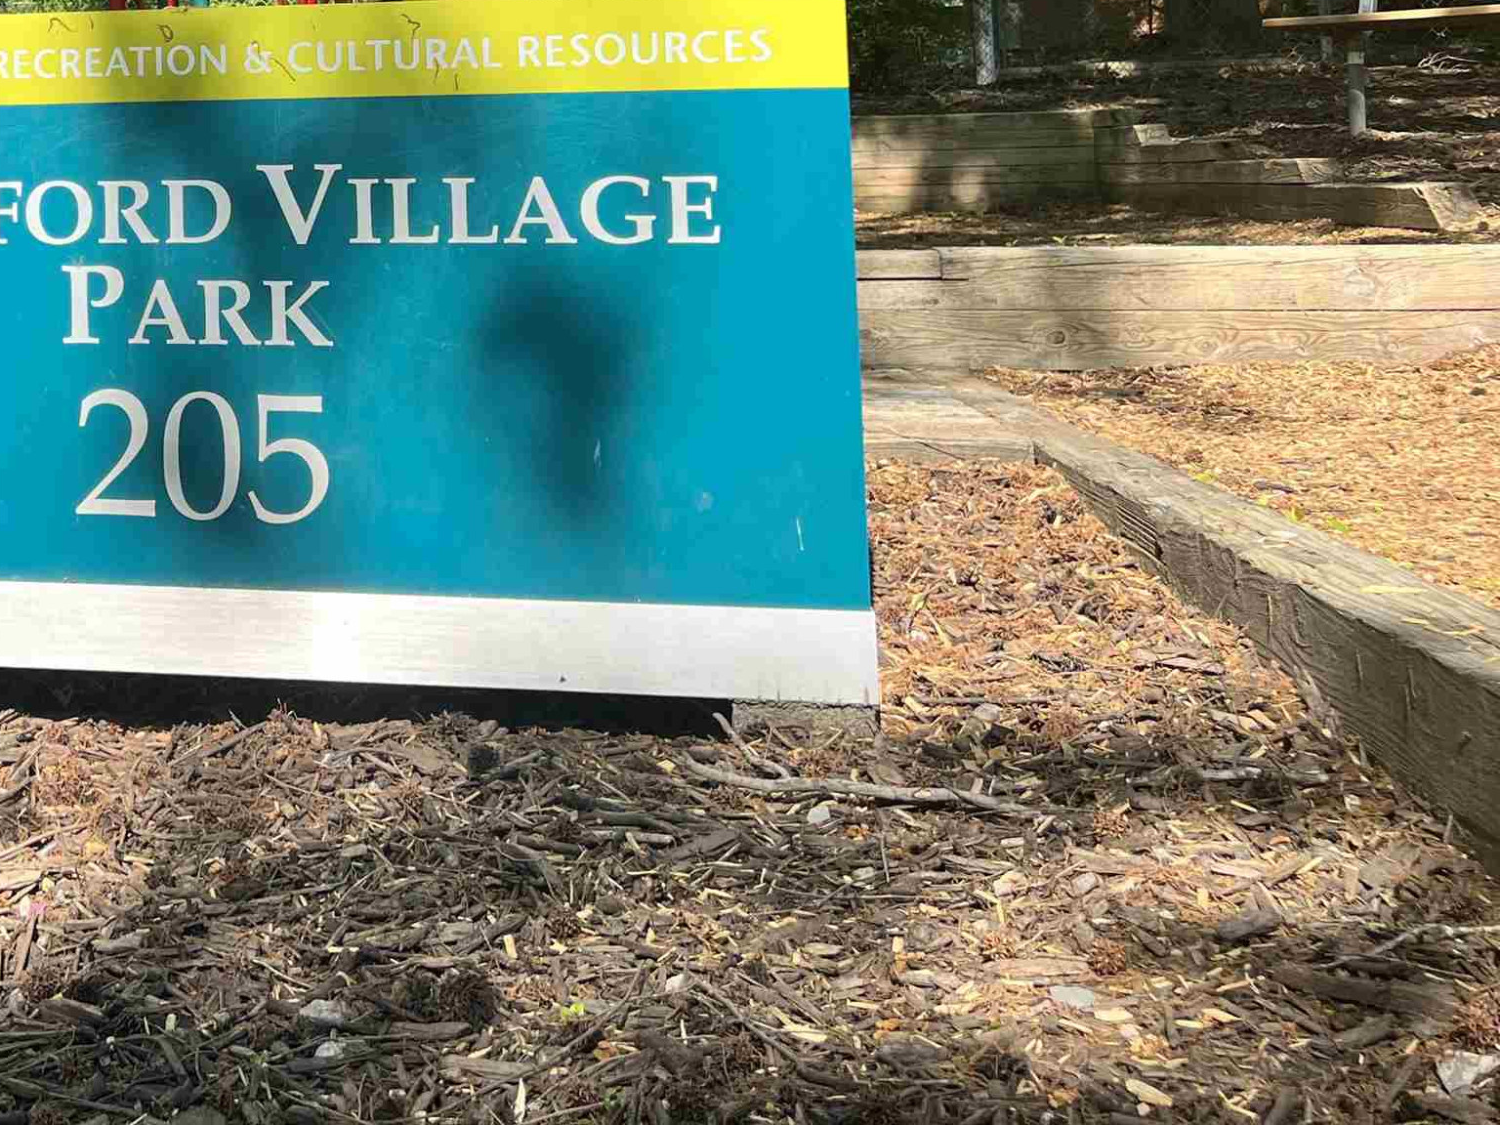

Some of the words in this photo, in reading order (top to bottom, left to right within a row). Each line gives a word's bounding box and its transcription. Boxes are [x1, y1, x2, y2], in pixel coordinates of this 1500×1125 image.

[243, 40, 274, 74] &
[287, 35, 502, 73] CULTURAL
[517, 28, 773, 66] RESOURCES
[256, 163, 722, 246] VILLAGE
[61, 264, 333, 346] PARK
[74, 388, 332, 525] 205
